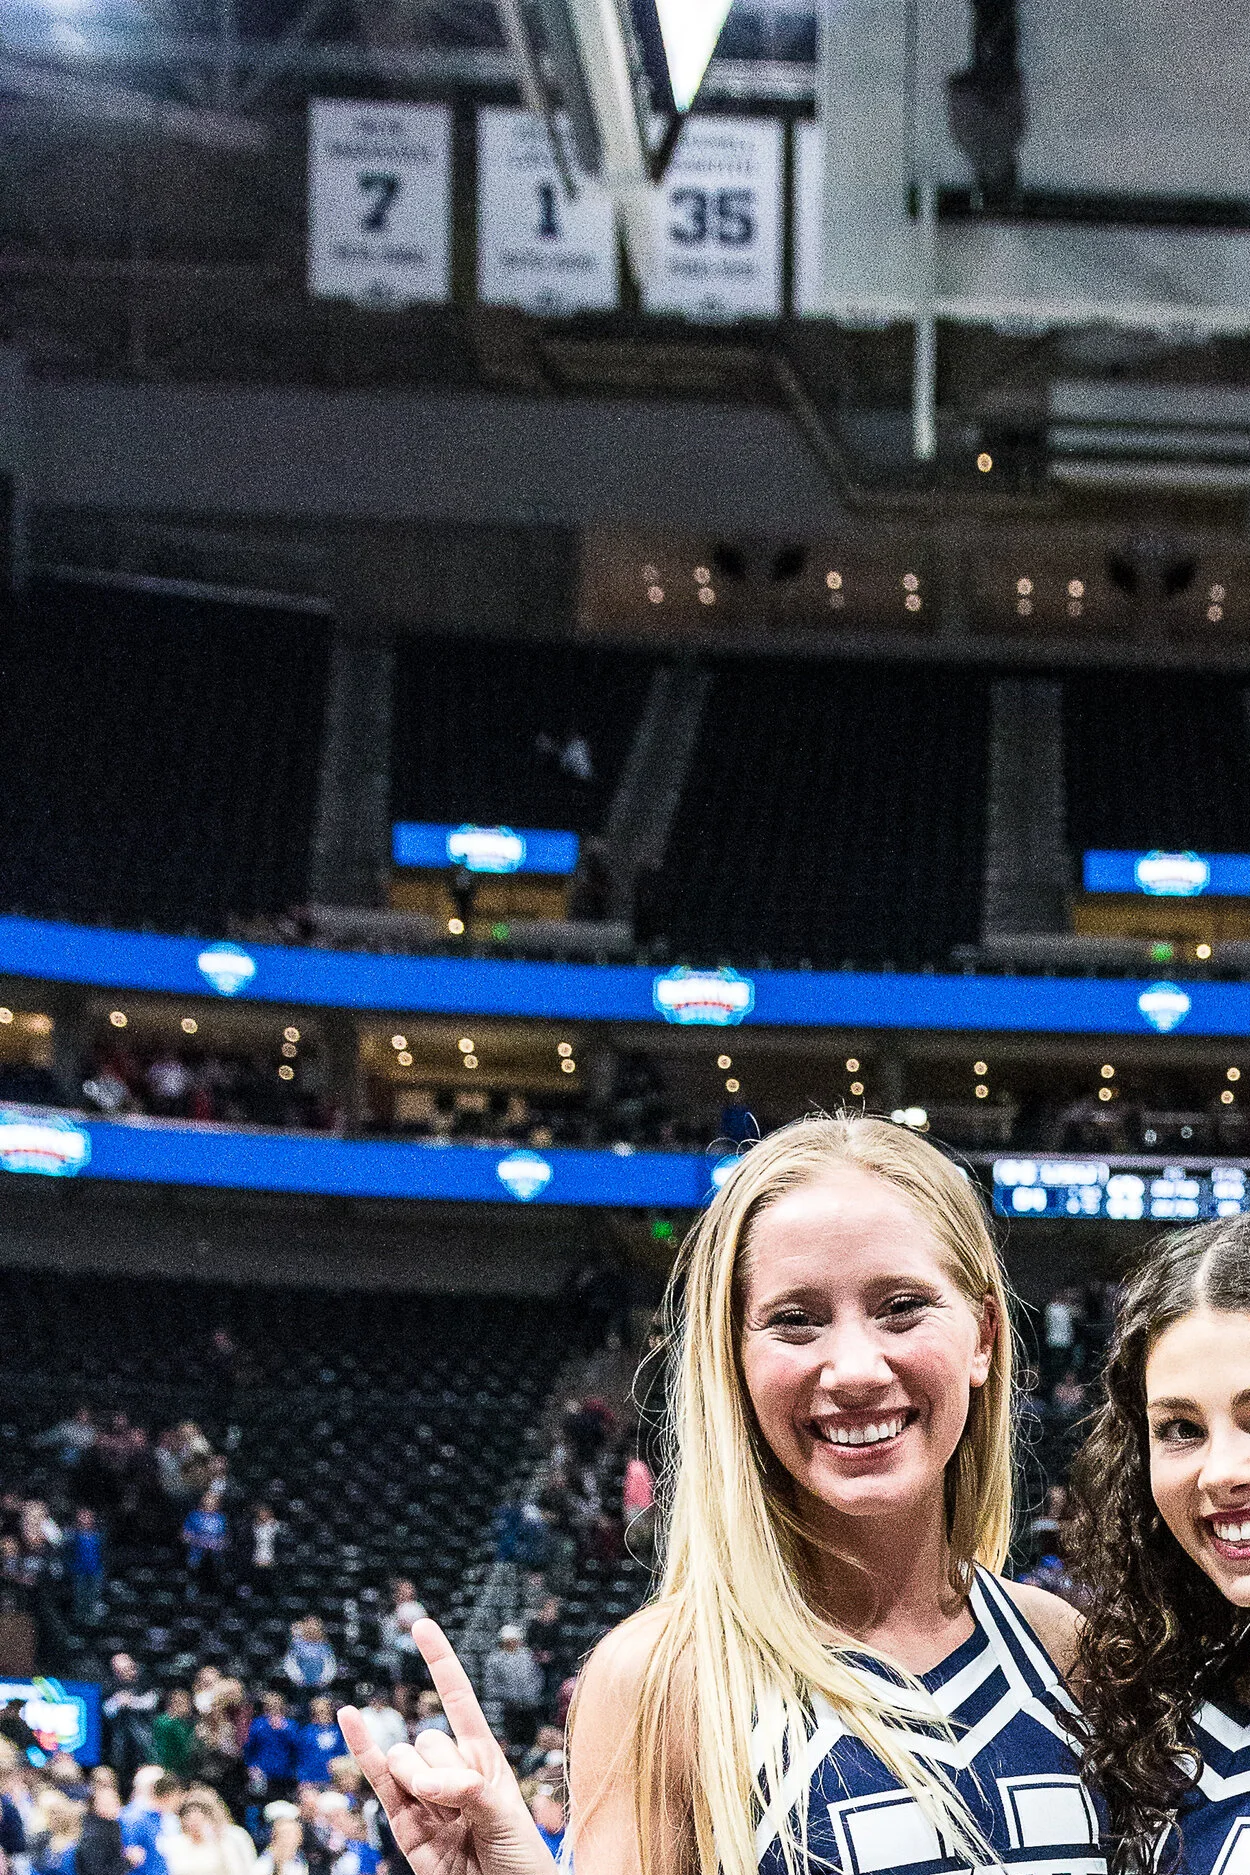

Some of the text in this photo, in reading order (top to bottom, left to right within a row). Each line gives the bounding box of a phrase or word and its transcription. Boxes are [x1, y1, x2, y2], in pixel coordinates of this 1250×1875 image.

[357, 171, 401, 231] 7
[536, 183, 561, 240] 1
[669, 187, 757, 246] 35
